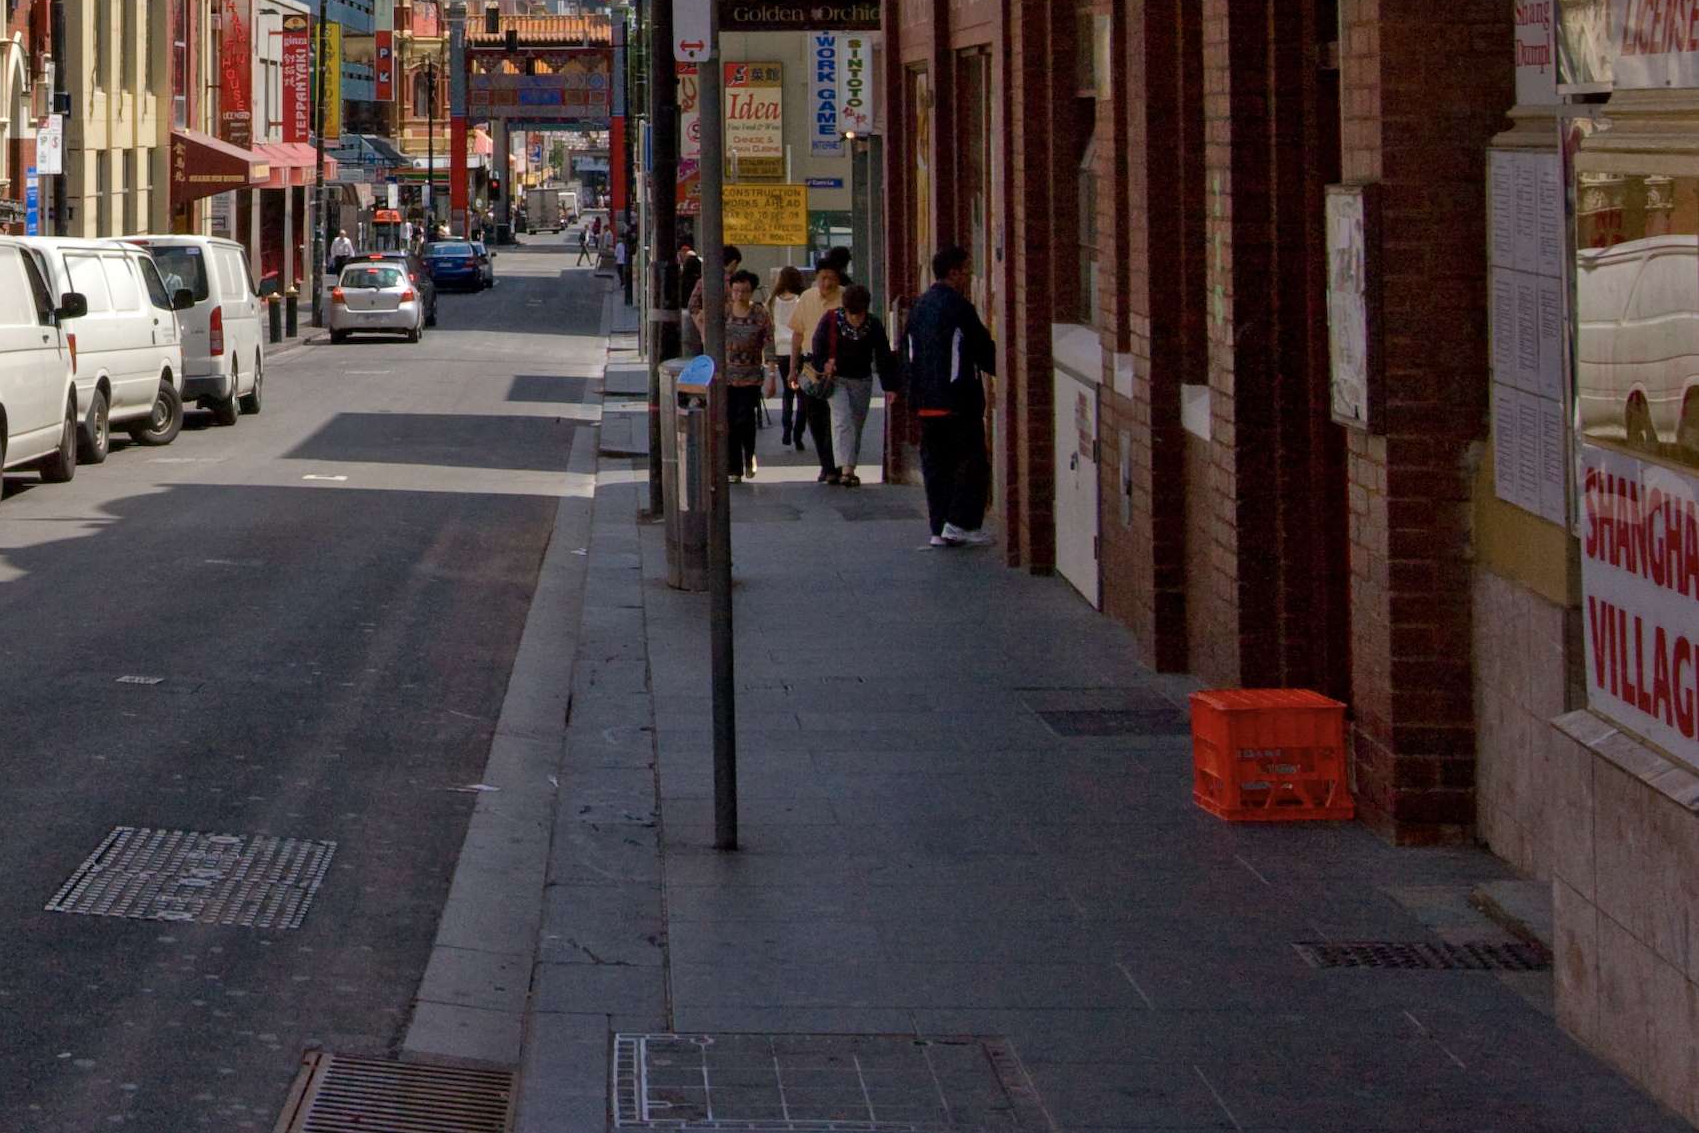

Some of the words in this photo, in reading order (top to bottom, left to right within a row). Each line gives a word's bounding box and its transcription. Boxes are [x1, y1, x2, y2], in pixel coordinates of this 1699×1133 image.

[733, 5, 804, 22] Golden
[380, 48, 388, 59] P
[296, 48, 308, 138] TEPPANYAKI
[727, 93, 781, 120] Idea
[816, 88, 837, 136] GAME
[723, 188, 801, 197] CONSTRUCTION
[764, 199, 801, 208] AHEAD
